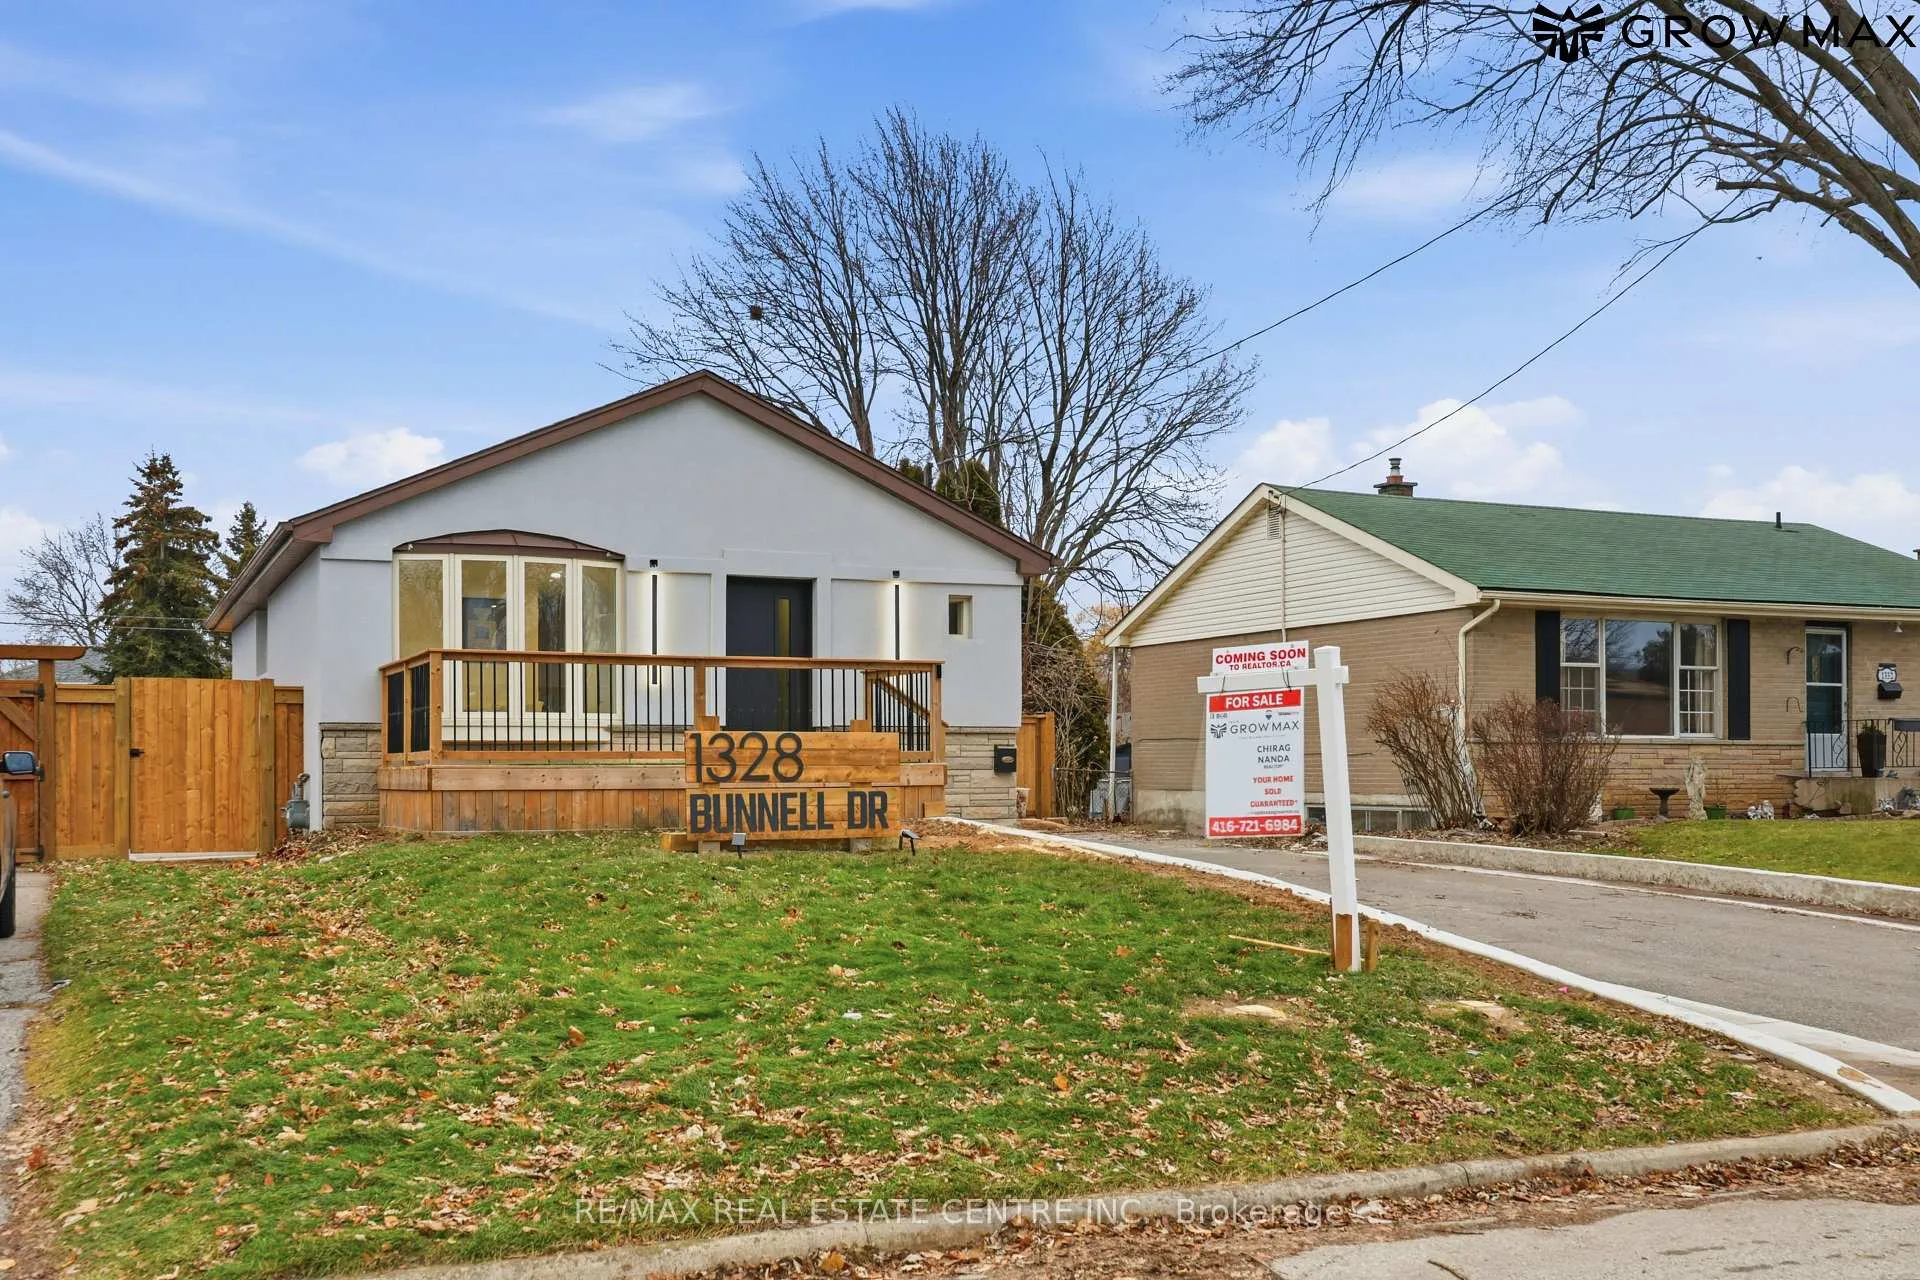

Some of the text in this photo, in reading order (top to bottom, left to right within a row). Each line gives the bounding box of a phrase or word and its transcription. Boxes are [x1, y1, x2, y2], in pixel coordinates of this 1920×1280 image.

[1215, 648, 1306, 664] COMING SOON
[1242, 660, 1292, 670] REALTOR.CA
[1225, 693, 1284, 709] FOR SALE
[1257, 744, 1291, 753] CHIRAG
[689, 732, 804, 783] 1328
[1257, 755, 1290, 764] NANDA
[1264, 787, 1282, 795] SOLD
[690, 790, 890, 834] BUNNELL DR
[1211, 818, 1299, 833] 416-721-6984
